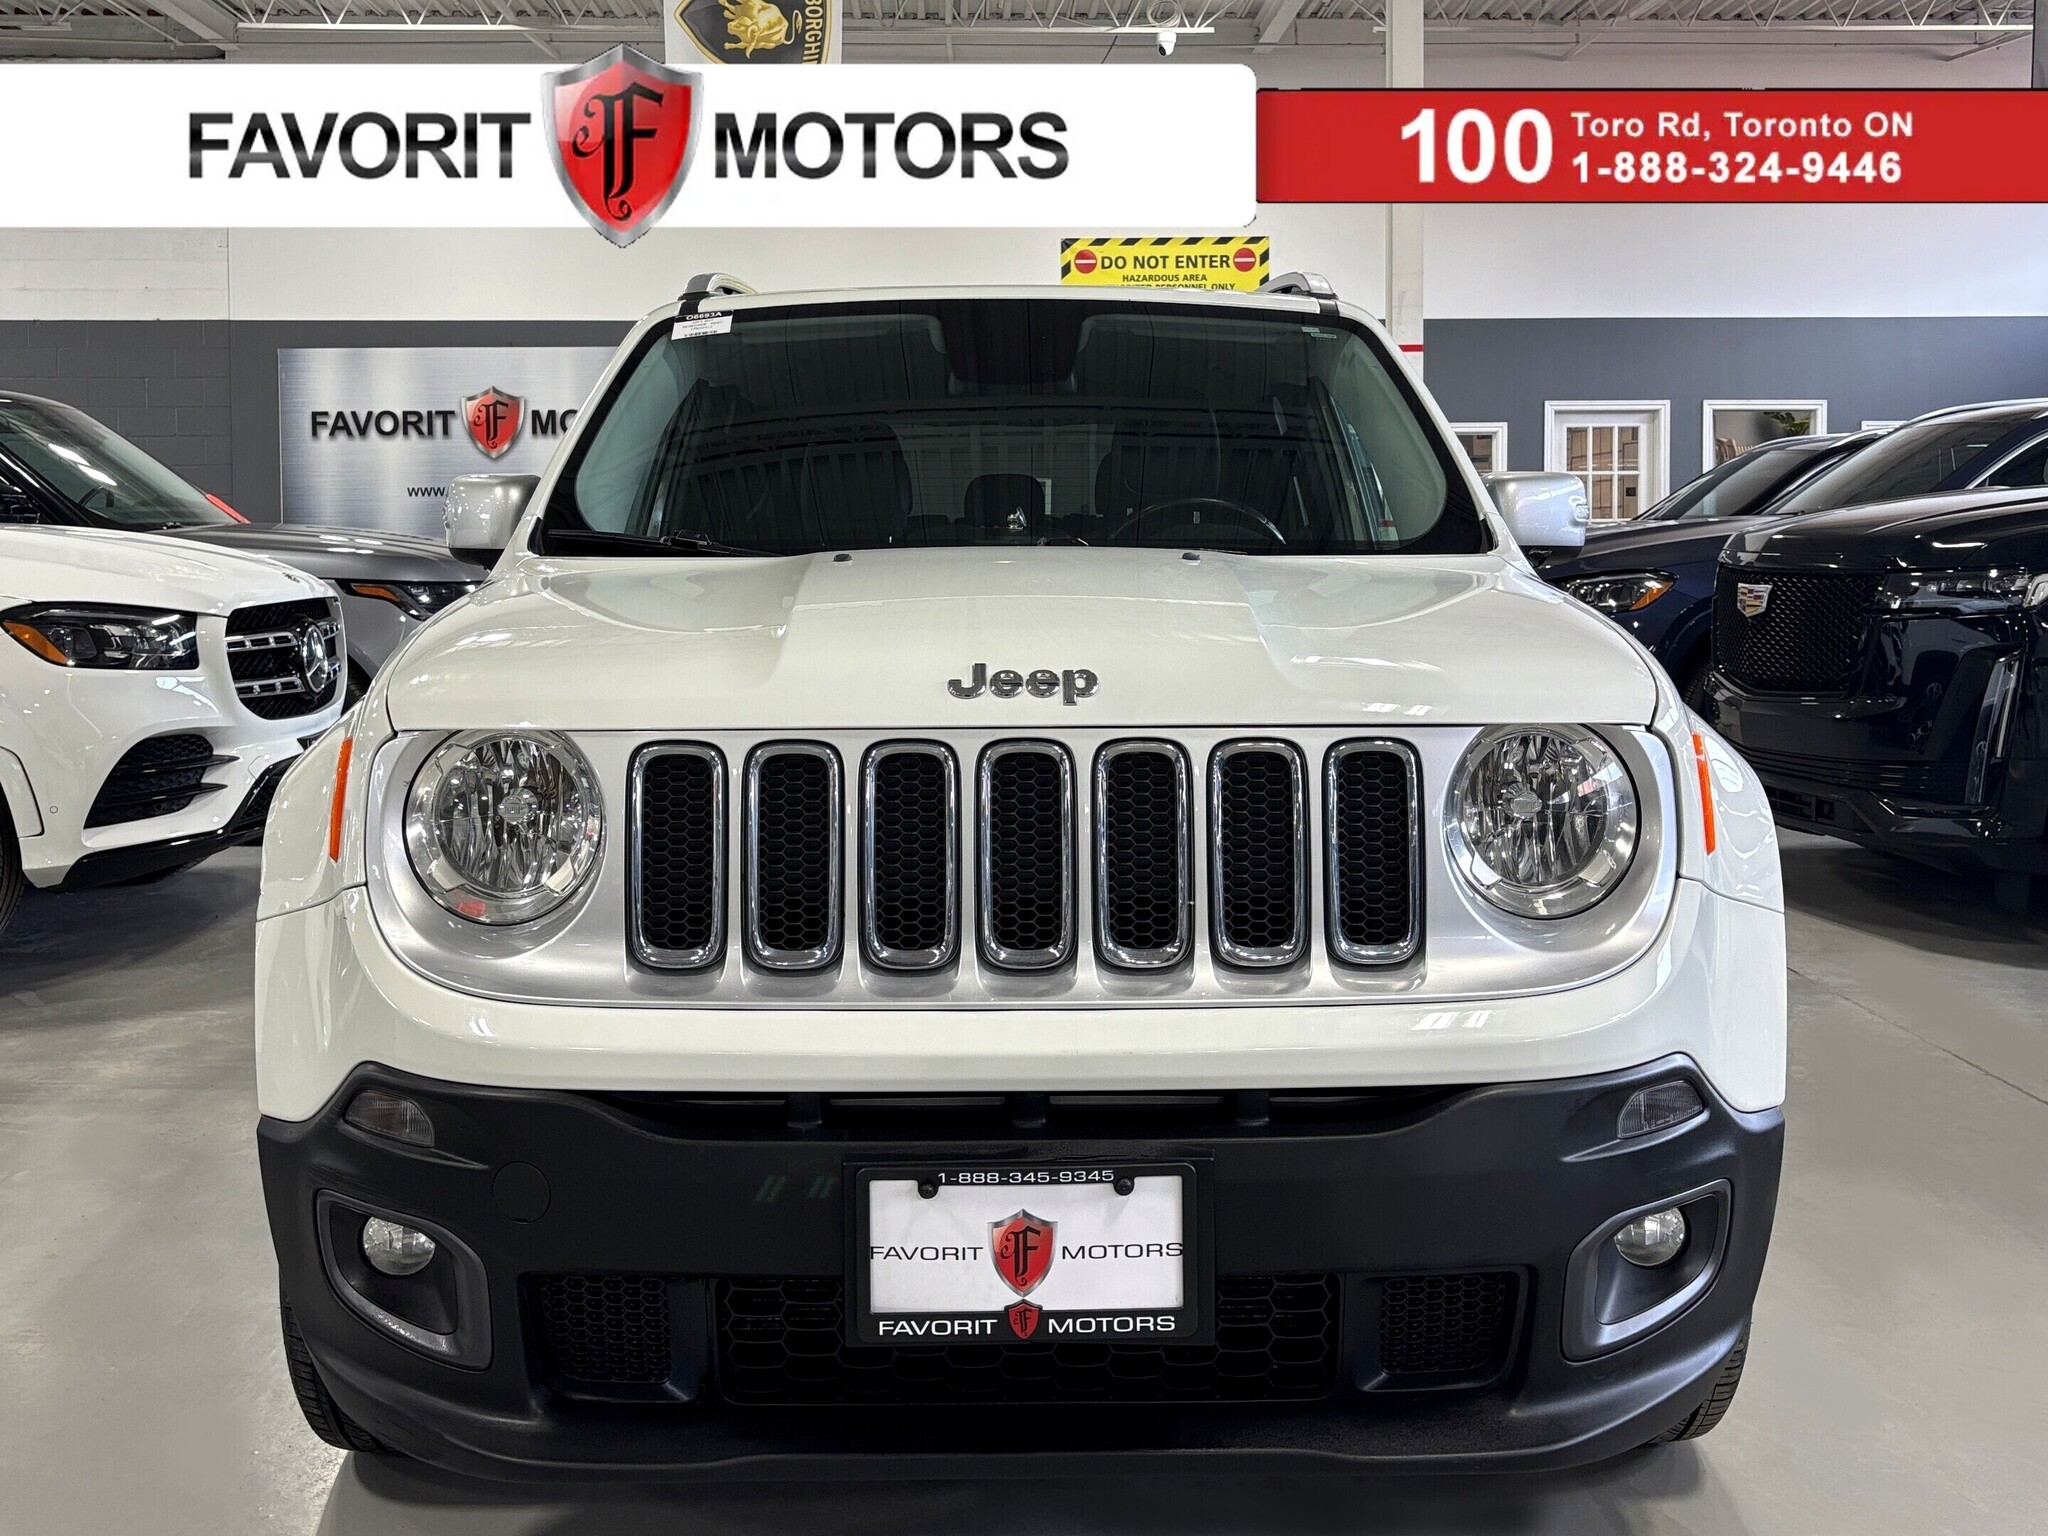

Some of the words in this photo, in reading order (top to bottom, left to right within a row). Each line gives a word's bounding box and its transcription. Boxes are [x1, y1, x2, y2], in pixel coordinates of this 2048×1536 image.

[1101, 256, 1127, 269] DO
[1133, 255, 1169, 269] NOT
[1175, 254, 1231, 269] ENTER
[1122, 274, 1179, 282] HAZARDOUS
[1182, 274, 1208, 282] AREA
[1211, 283, 1236, 291] ONLY
[311, 410, 455, 437] FAVORIT
[948, 663, 1100, 706] Jeep
[938, 1170, 1115, 1184] 1-888-345-9345
[870, 1246, 983, 1261] FAVORIT
[1062, 1242, 1183, 1260] MOTORS
[878, 1319, 998, 1336] FAVORIT
[1048, 1315, 1176, 1334] MOTORS
